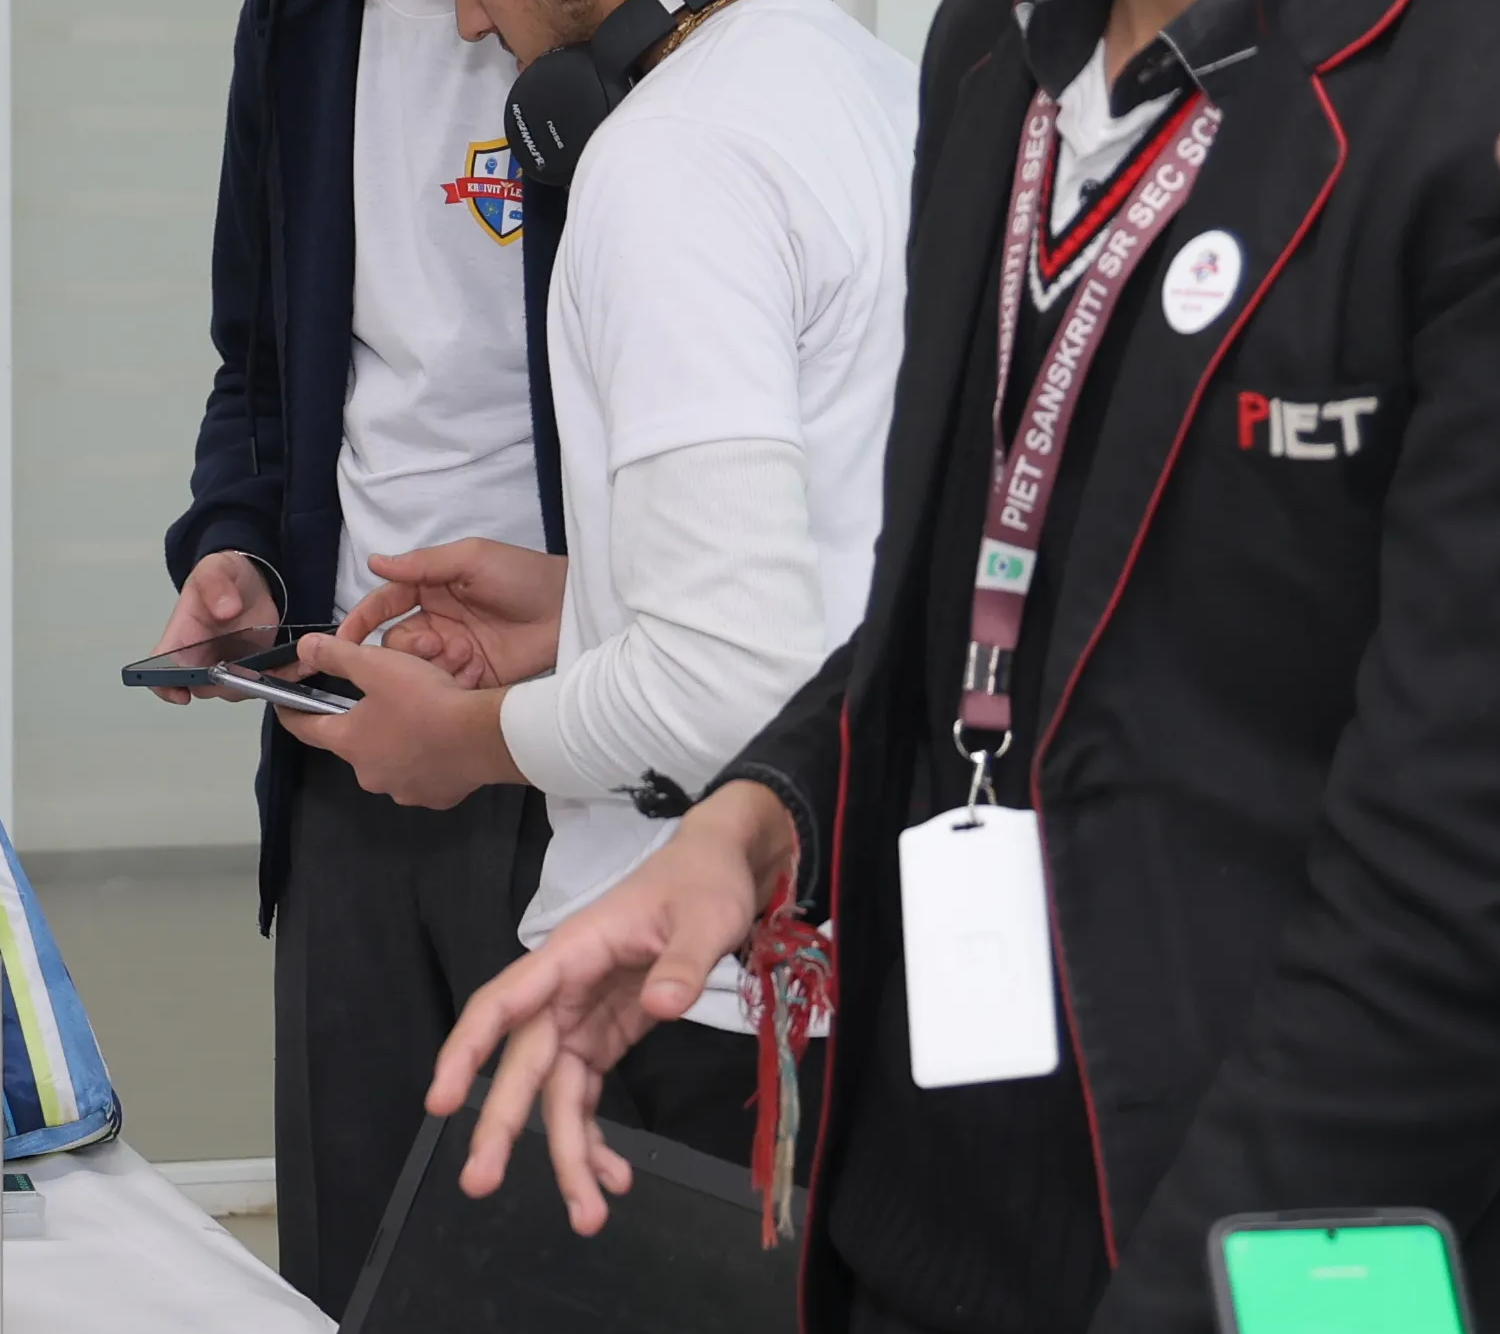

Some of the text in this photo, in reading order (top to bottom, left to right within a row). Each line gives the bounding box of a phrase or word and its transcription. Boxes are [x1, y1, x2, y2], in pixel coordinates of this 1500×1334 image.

[547, 120, 564, 150] noise
[1022, 114, 1050, 183] SEC
[1012, 188, 1036, 237] SR
[1000, 454, 1045, 533] PIET
[1025, 279, 1109, 456] SANSKRITI
[1097, 229, 1139, 279] SR
[1127, 163, 1185, 230] SEC
[1238, 390, 1379, 461] PIET
